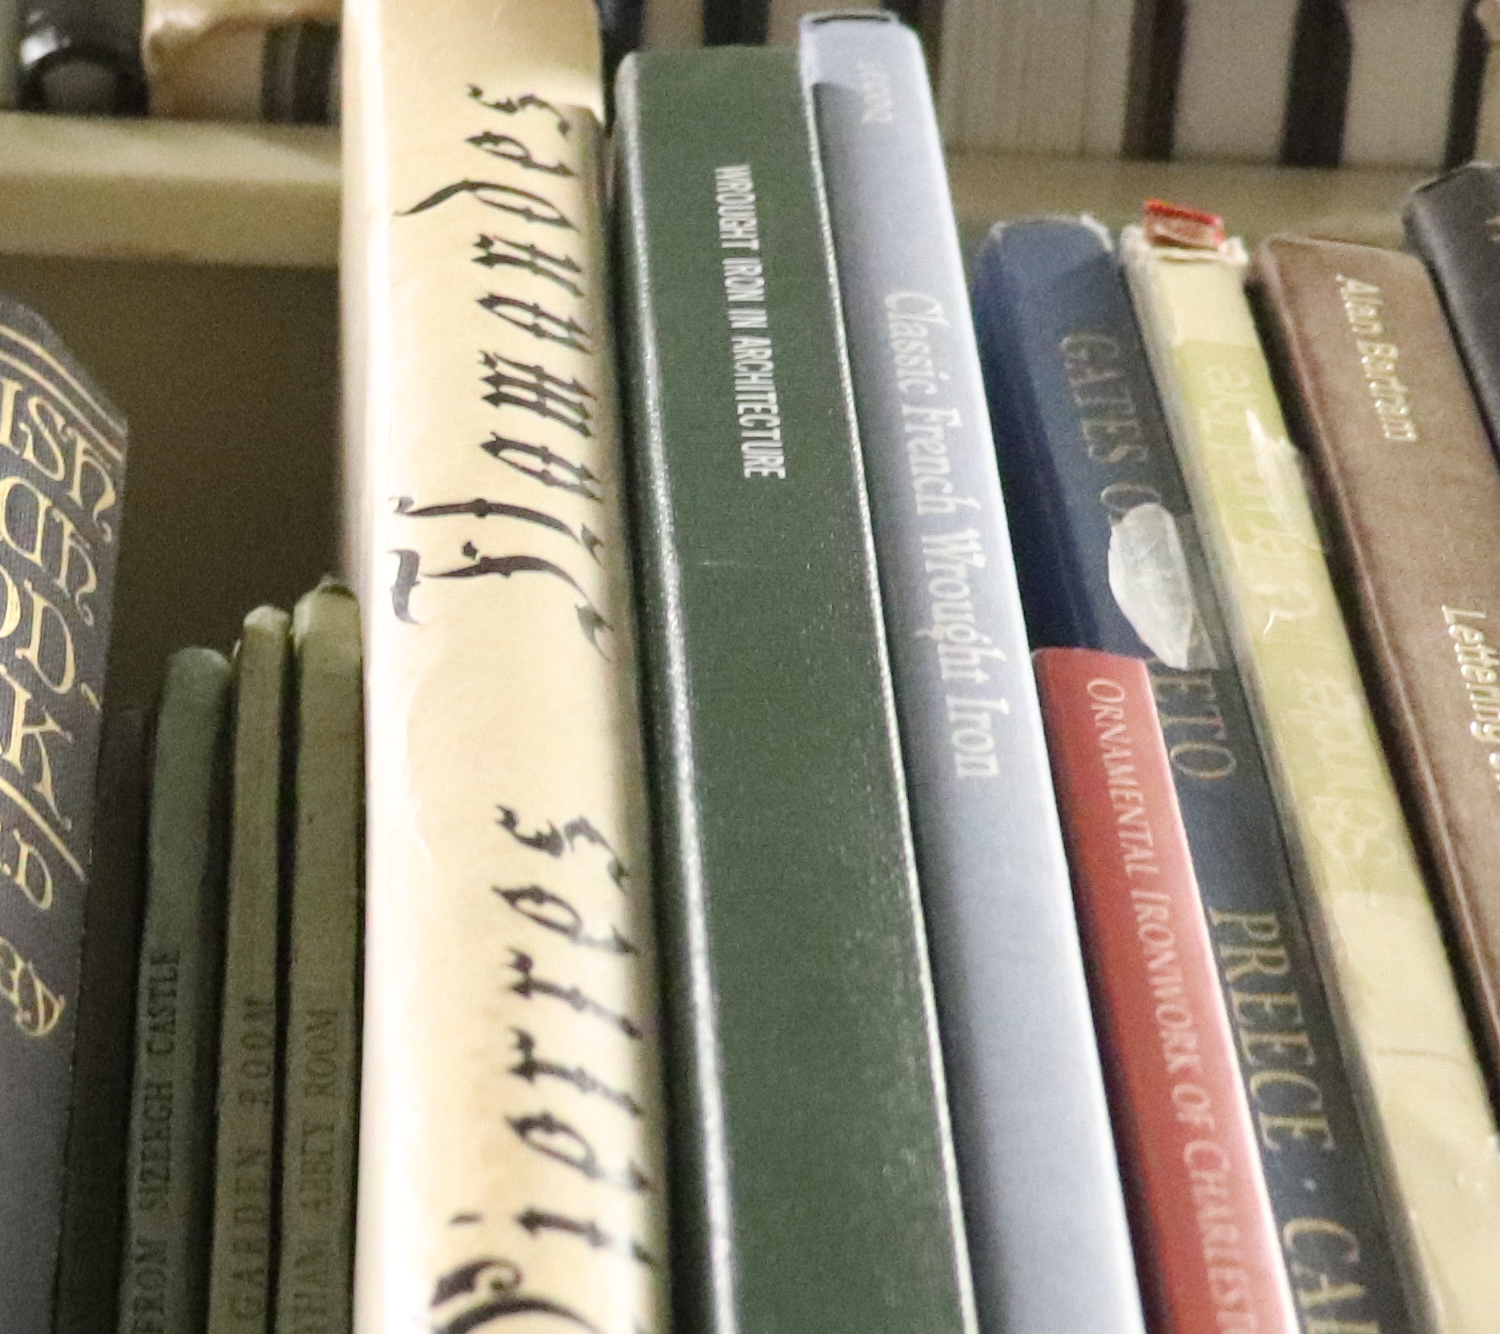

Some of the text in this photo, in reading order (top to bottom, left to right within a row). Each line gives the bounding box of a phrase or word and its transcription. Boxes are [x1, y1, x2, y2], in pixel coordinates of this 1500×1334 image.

[377, 80, 618, 660] Flamandes
[710, 165, 787, 480] WROUGHT IRON IN ARCHITECTURE
[1054, 330, 1148, 463] GATES
[1334, 274, 1421, 444] Alan Bartram
[881, 290, 1021, 778] Classic French Wrought Iron
[144, 949, 181, 1057] CASTLE
[1084, 678, 1160, 879] ORNAMENTAL
[1128, 889, 1208, 1070] IRONWORK
[1170, 1083, 1217, 1129] OF
[1203, 908, 1338, 1154] PREECE
